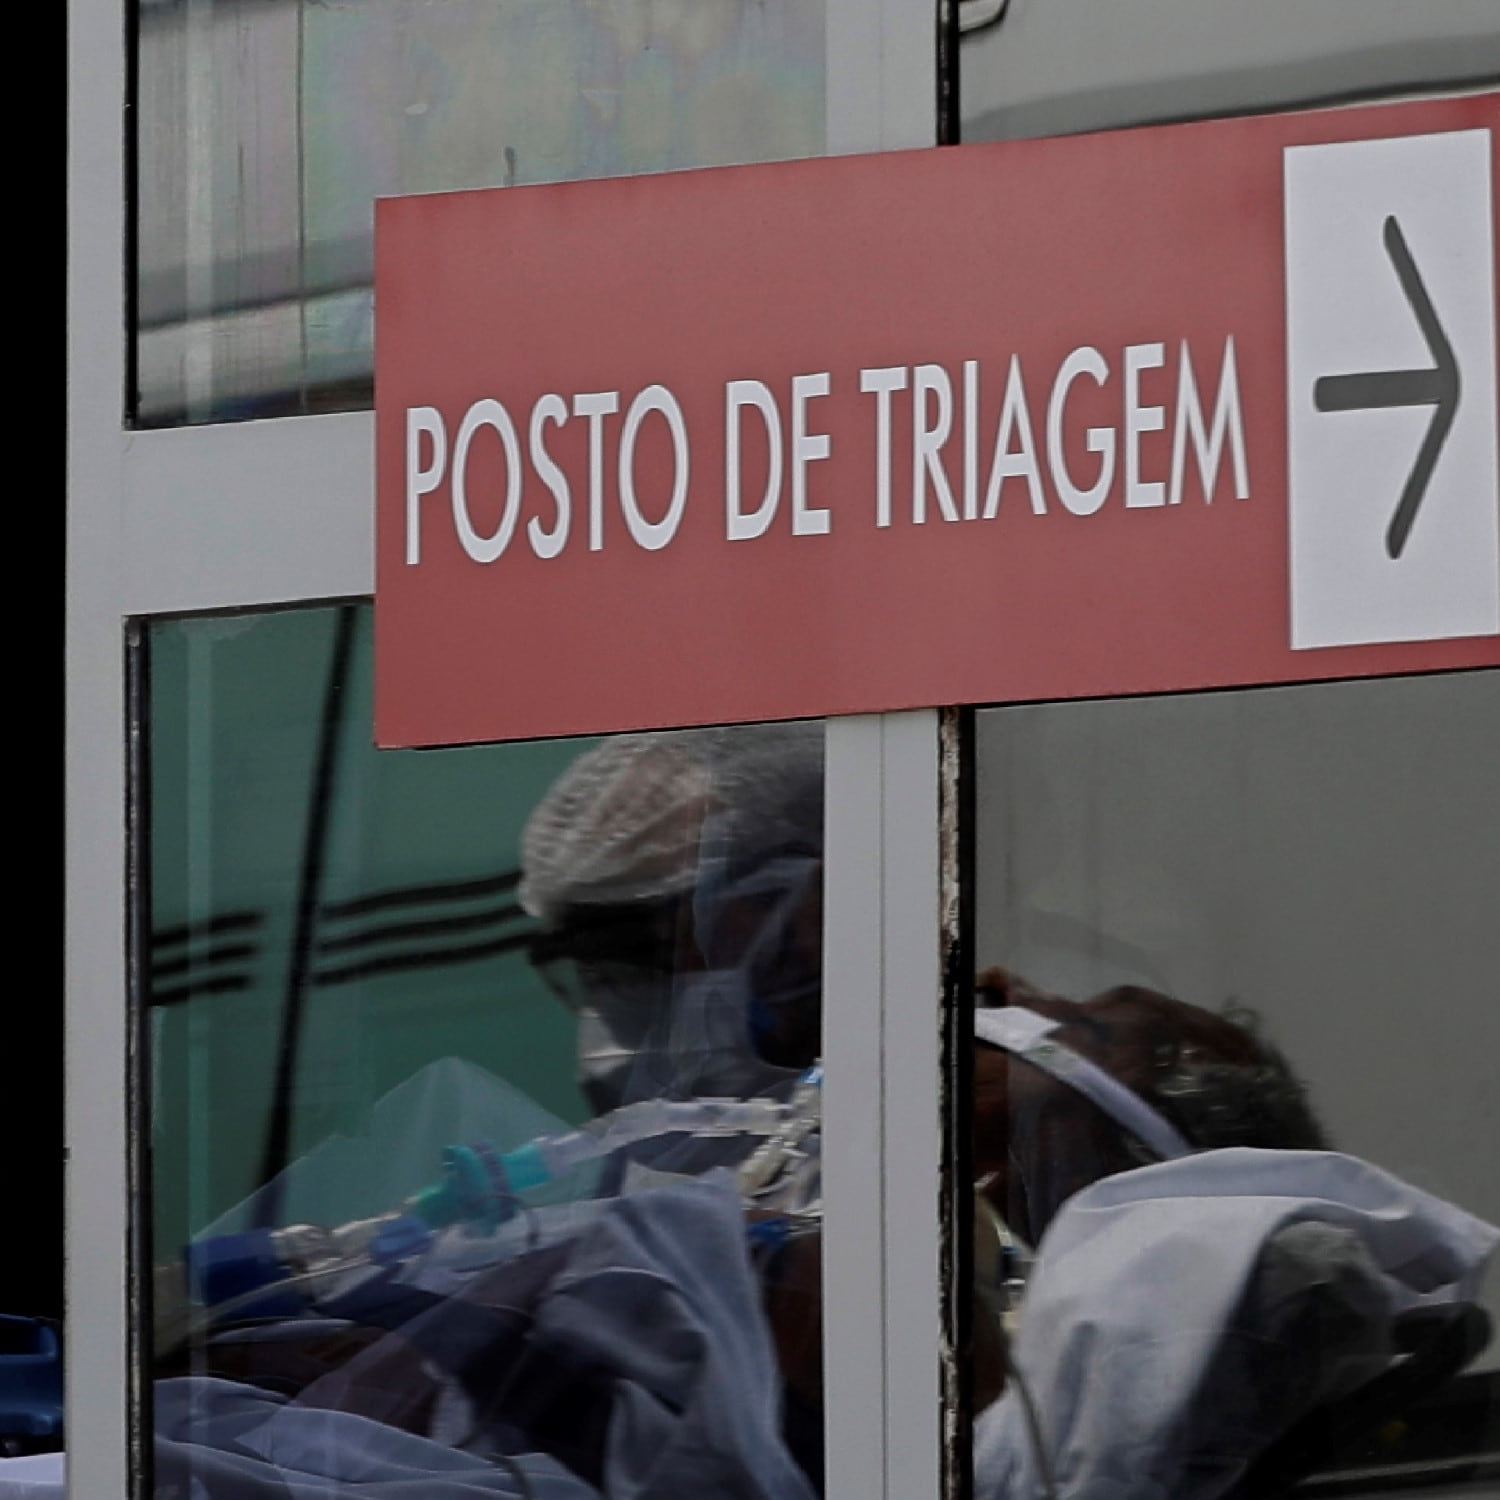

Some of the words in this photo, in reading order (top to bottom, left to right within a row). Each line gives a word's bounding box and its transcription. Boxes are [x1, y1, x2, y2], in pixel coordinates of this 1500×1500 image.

[406, 384, 689, 565] POSTO
[726, 372, 831, 541] DE
[860, 335, 1250, 527] TRIAGEM
